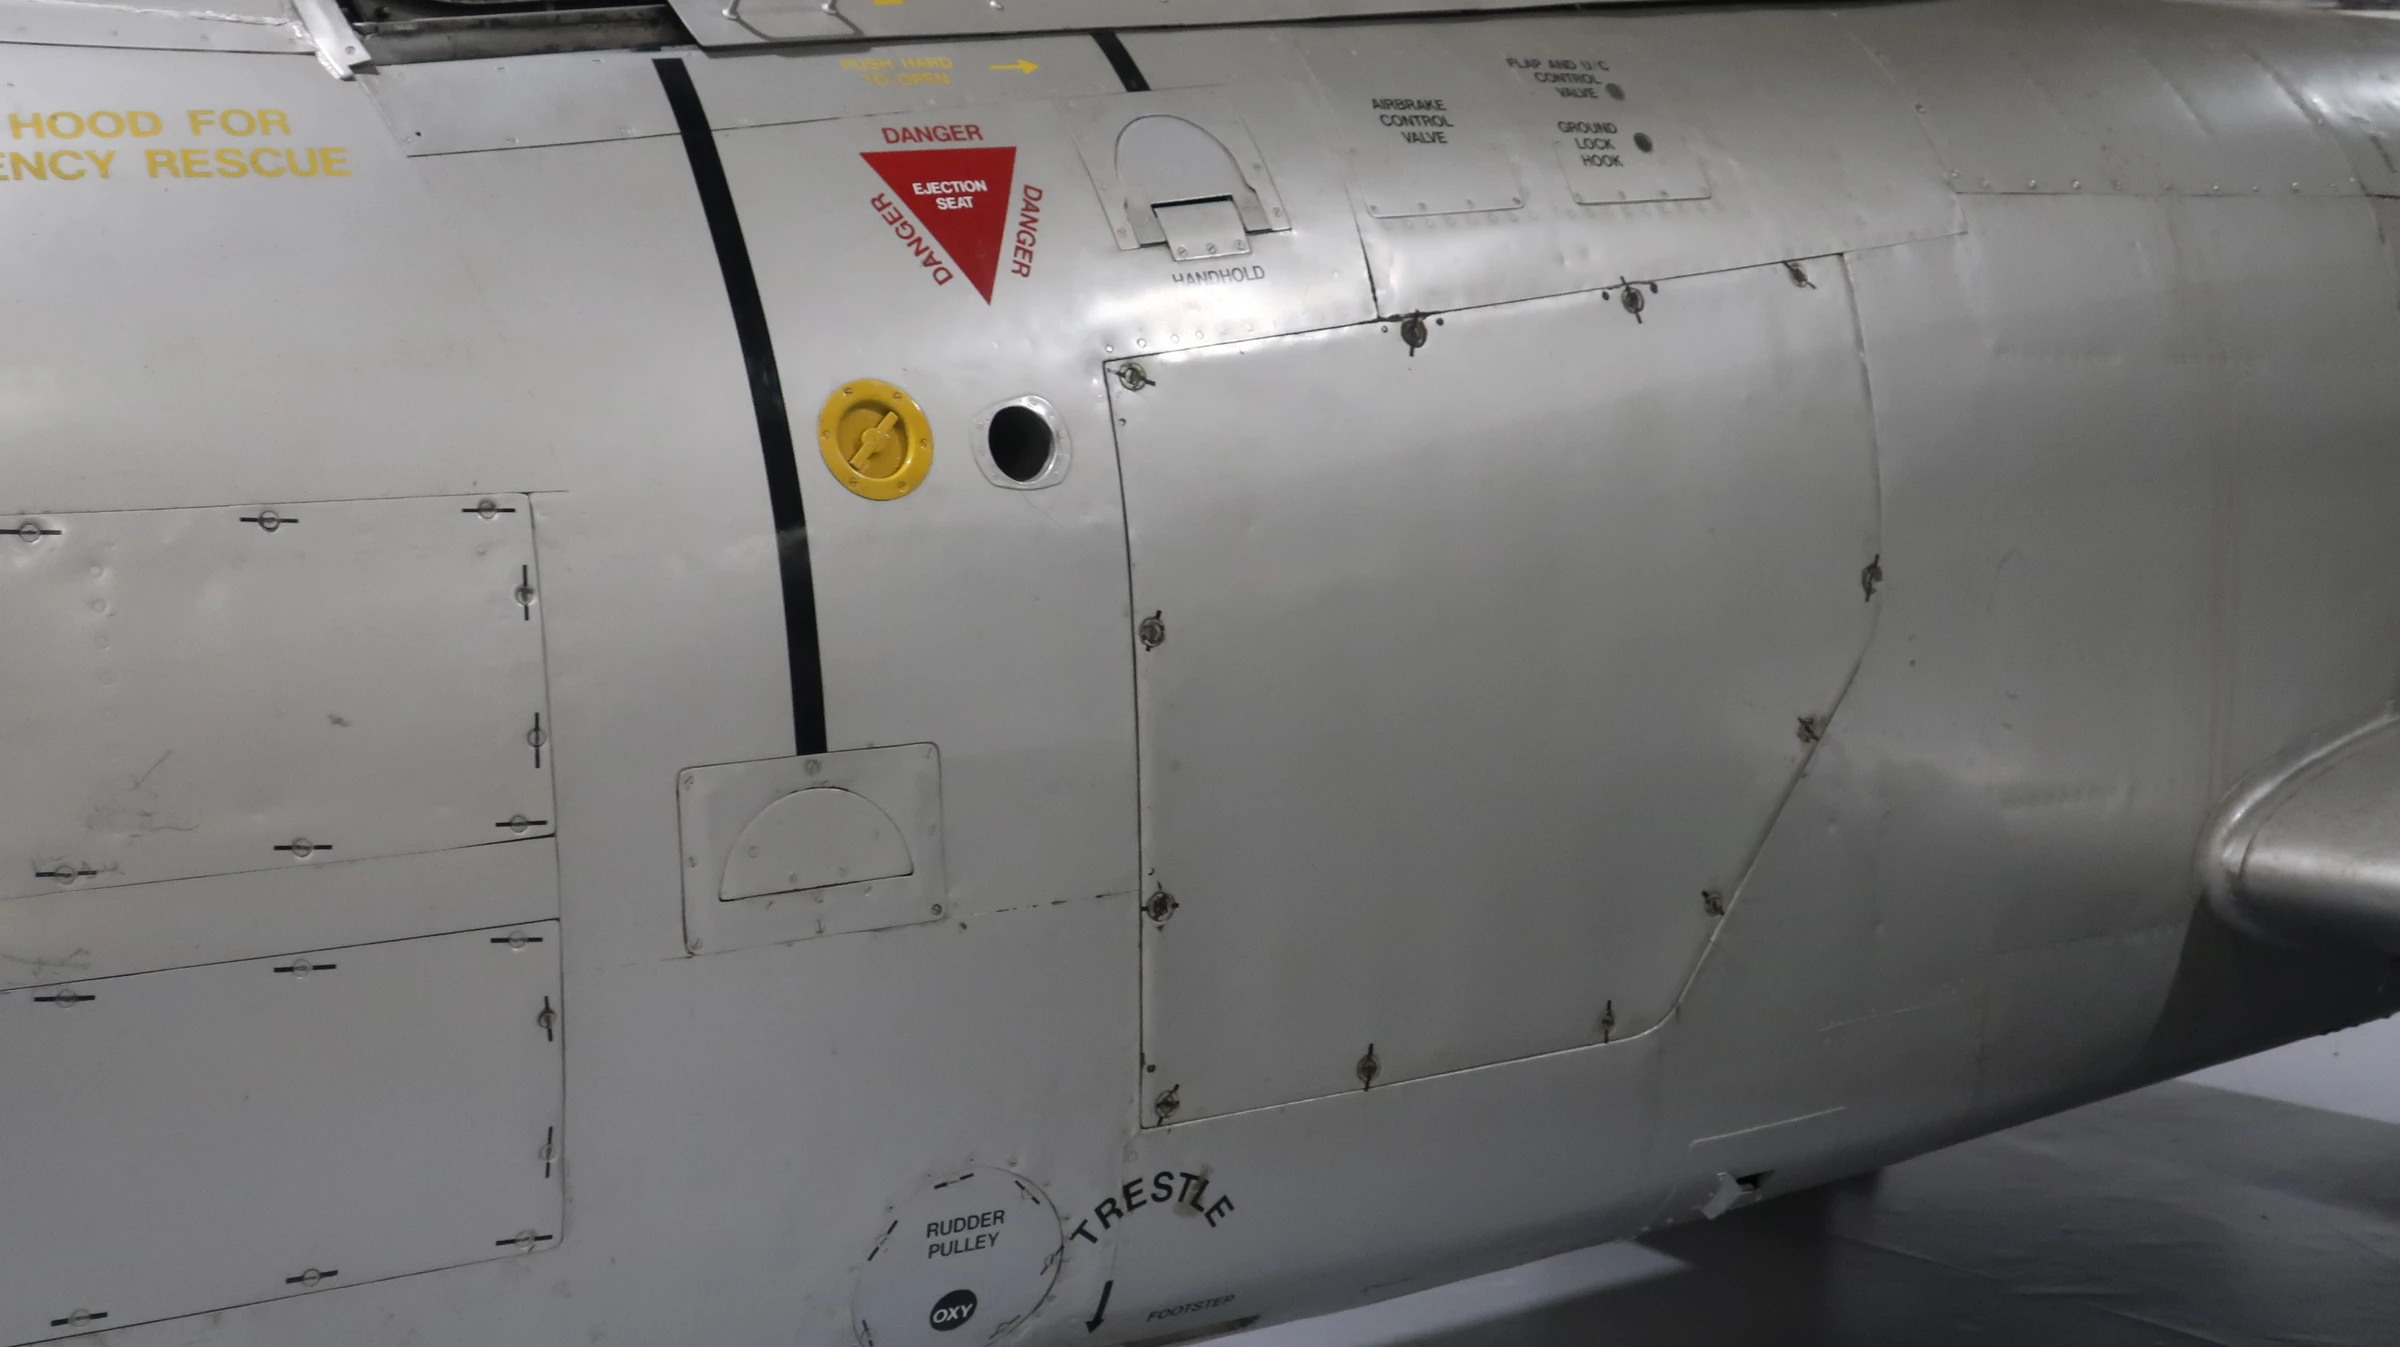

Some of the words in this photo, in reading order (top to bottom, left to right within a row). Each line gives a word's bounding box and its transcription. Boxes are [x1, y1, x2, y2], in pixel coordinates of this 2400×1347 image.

[1506, 57, 1541, 69] FLAP
[1549, 59, 1577, 70] AND
[862, 73, 891, 87] TO
[1534, 72, 1603, 85] CONTROL
[1554, 86, 1599, 99] VALVE
[1371, 98, 1447, 111] AIRBRAKE
[7, 110, 164, 140] HOOD
[186, 108, 292, 137] FOR
[1379, 113, 1455, 127] CONTROL
[1557, 120, 1618, 134] GROUND
[881, 124, 984, 144] DANGER
[1401, 131, 1449, 144] VALVE
[1575, 137, 1616, 150] LOCK
[144, 146, 354, 179] RESCUE
[1581, 154, 1625, 167] HOOK
[912, 179, 988, 195] EJECTION
[935, 196, 974, 210] SEAT
[1011, 183, 1043, 278] DANGER
[870, 192, 954, 286] DANGER
[1171, 264, 1266, 286] HANDHOLD
[1068, 1170, 1236, 1246] TRESTLE
[926, 1209, 1005, 1239] RUDDER
[928, 1231, 1000, 1260] PULLEY
[932, 1303, 974, 1325] OXY
[1146, 1294, 1236, 1323] FOOTSTEP
